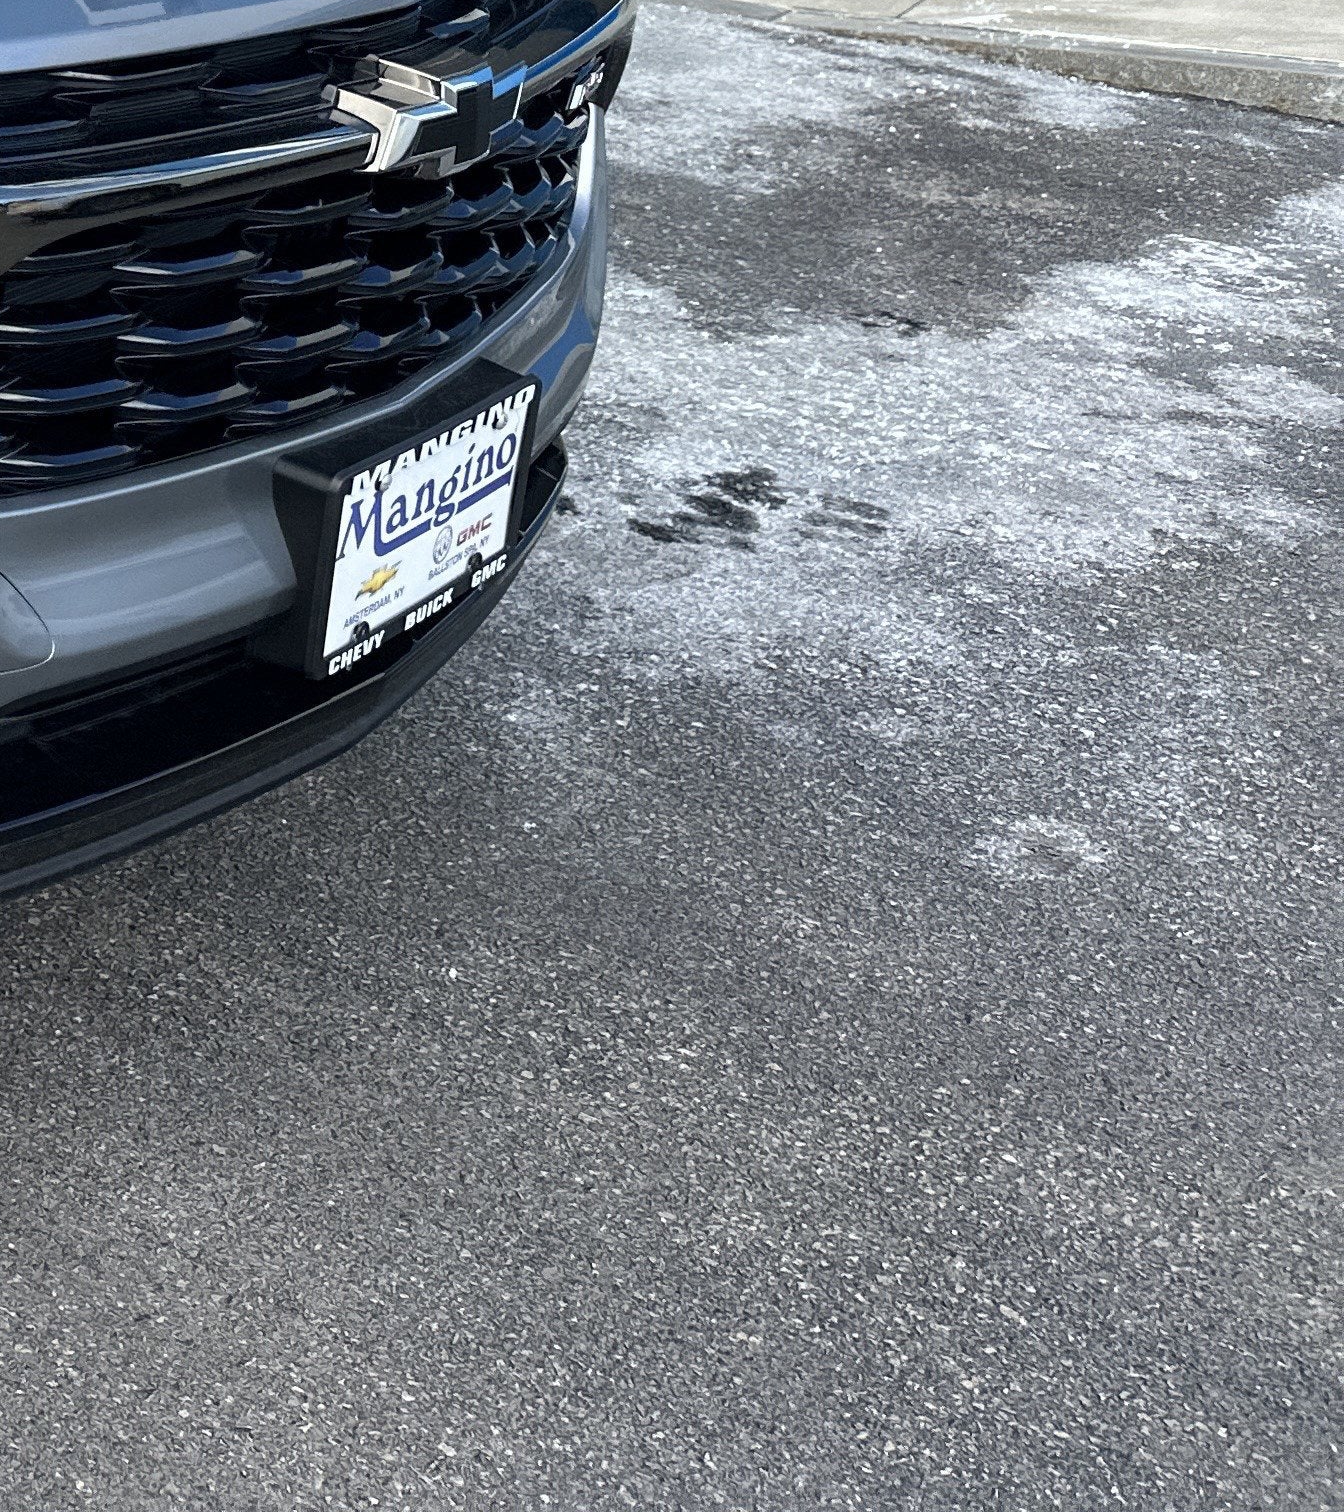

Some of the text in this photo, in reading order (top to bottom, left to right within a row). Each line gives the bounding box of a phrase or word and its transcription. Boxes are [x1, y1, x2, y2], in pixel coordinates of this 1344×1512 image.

[351, 384, 536, 495] MANGINO
[335, 432, 517, 560] Mangino
[456, 512, 493, 547] GMC
[328, 554, 508, 675] CHEVY BUICK GMC
[393, 585, 405, 600] NY
